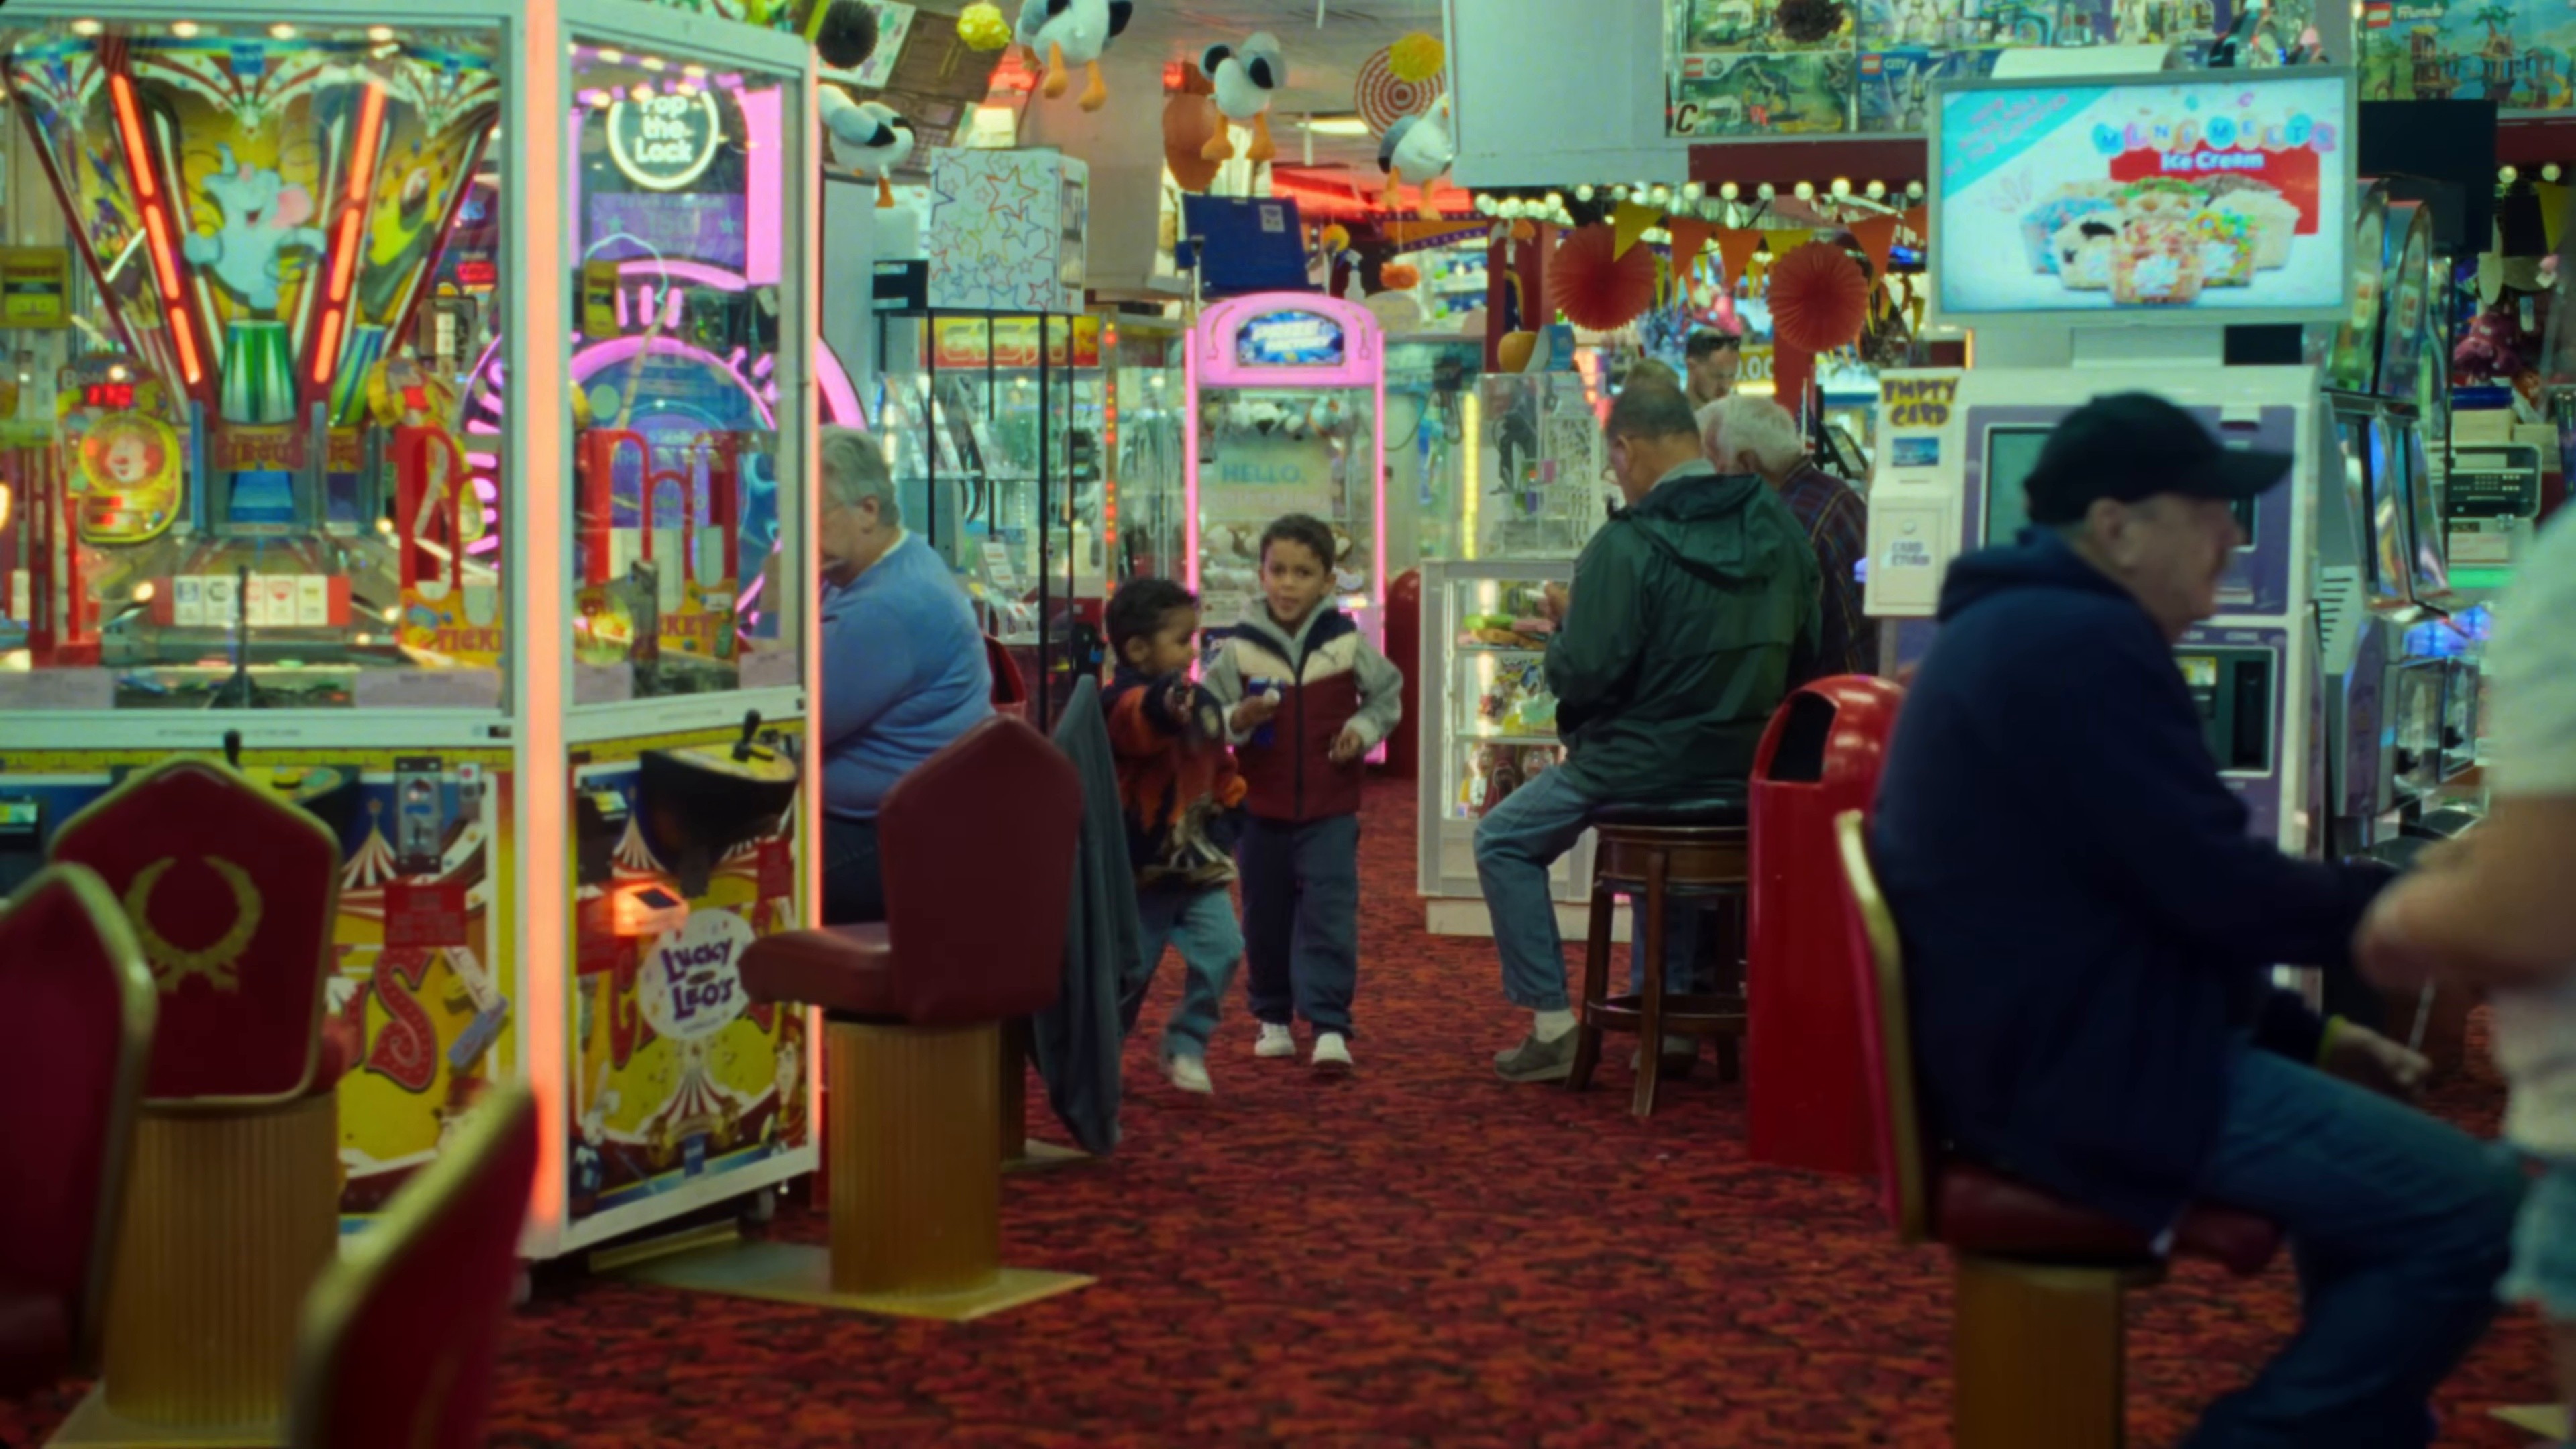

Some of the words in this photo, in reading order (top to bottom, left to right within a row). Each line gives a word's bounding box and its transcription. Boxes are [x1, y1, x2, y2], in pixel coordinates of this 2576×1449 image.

[643, 115, 686, 140] the
[635, 136, 693, 163] Lock
[2161, 152, 2192, 170] Ice
[2195, 151, 2265, 168] Cream
[1882, 376, 1960, 403] EMPTY
[1891, 403, 1949, 427] CARD
